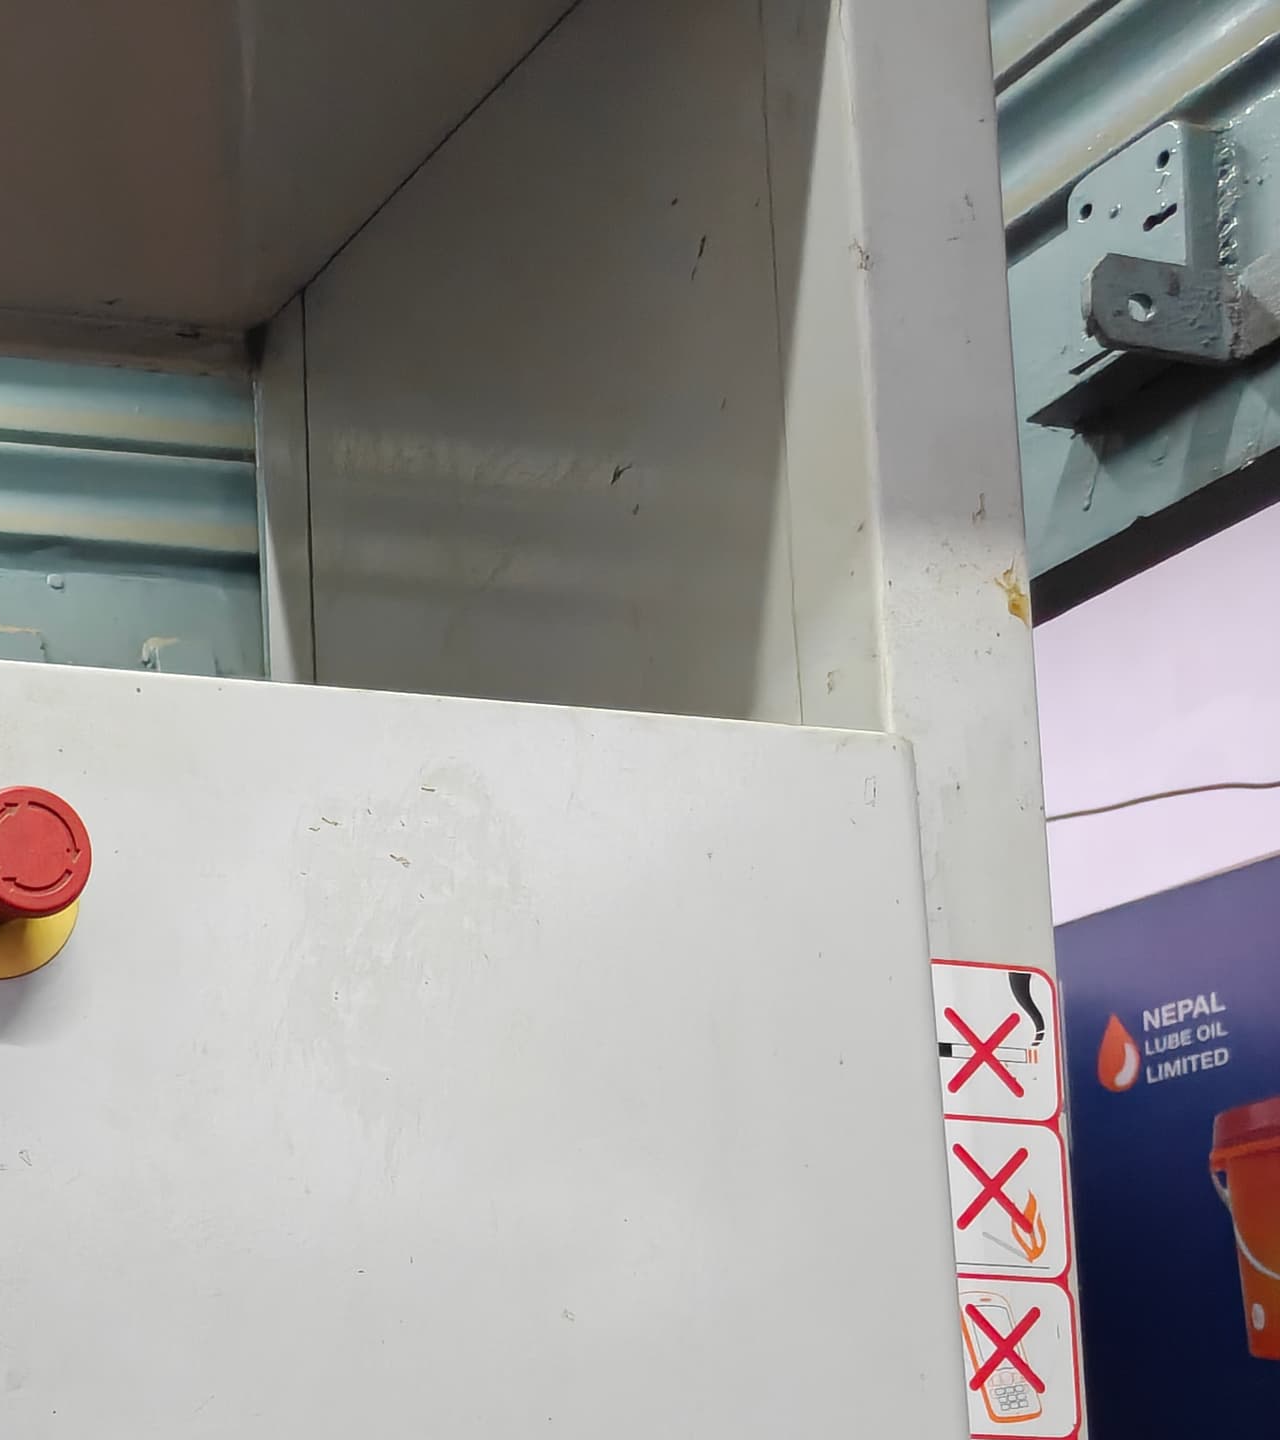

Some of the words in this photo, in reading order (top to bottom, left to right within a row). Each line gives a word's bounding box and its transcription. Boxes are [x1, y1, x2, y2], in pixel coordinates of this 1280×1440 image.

[1143, 992, 1226, 1032] NEPAL
[1145, 1029, 1192, 1056] LUBE
[1197, 1021, 1228, 1042] OIL
[1147, 1048, 1229, 1084] LIMITED
